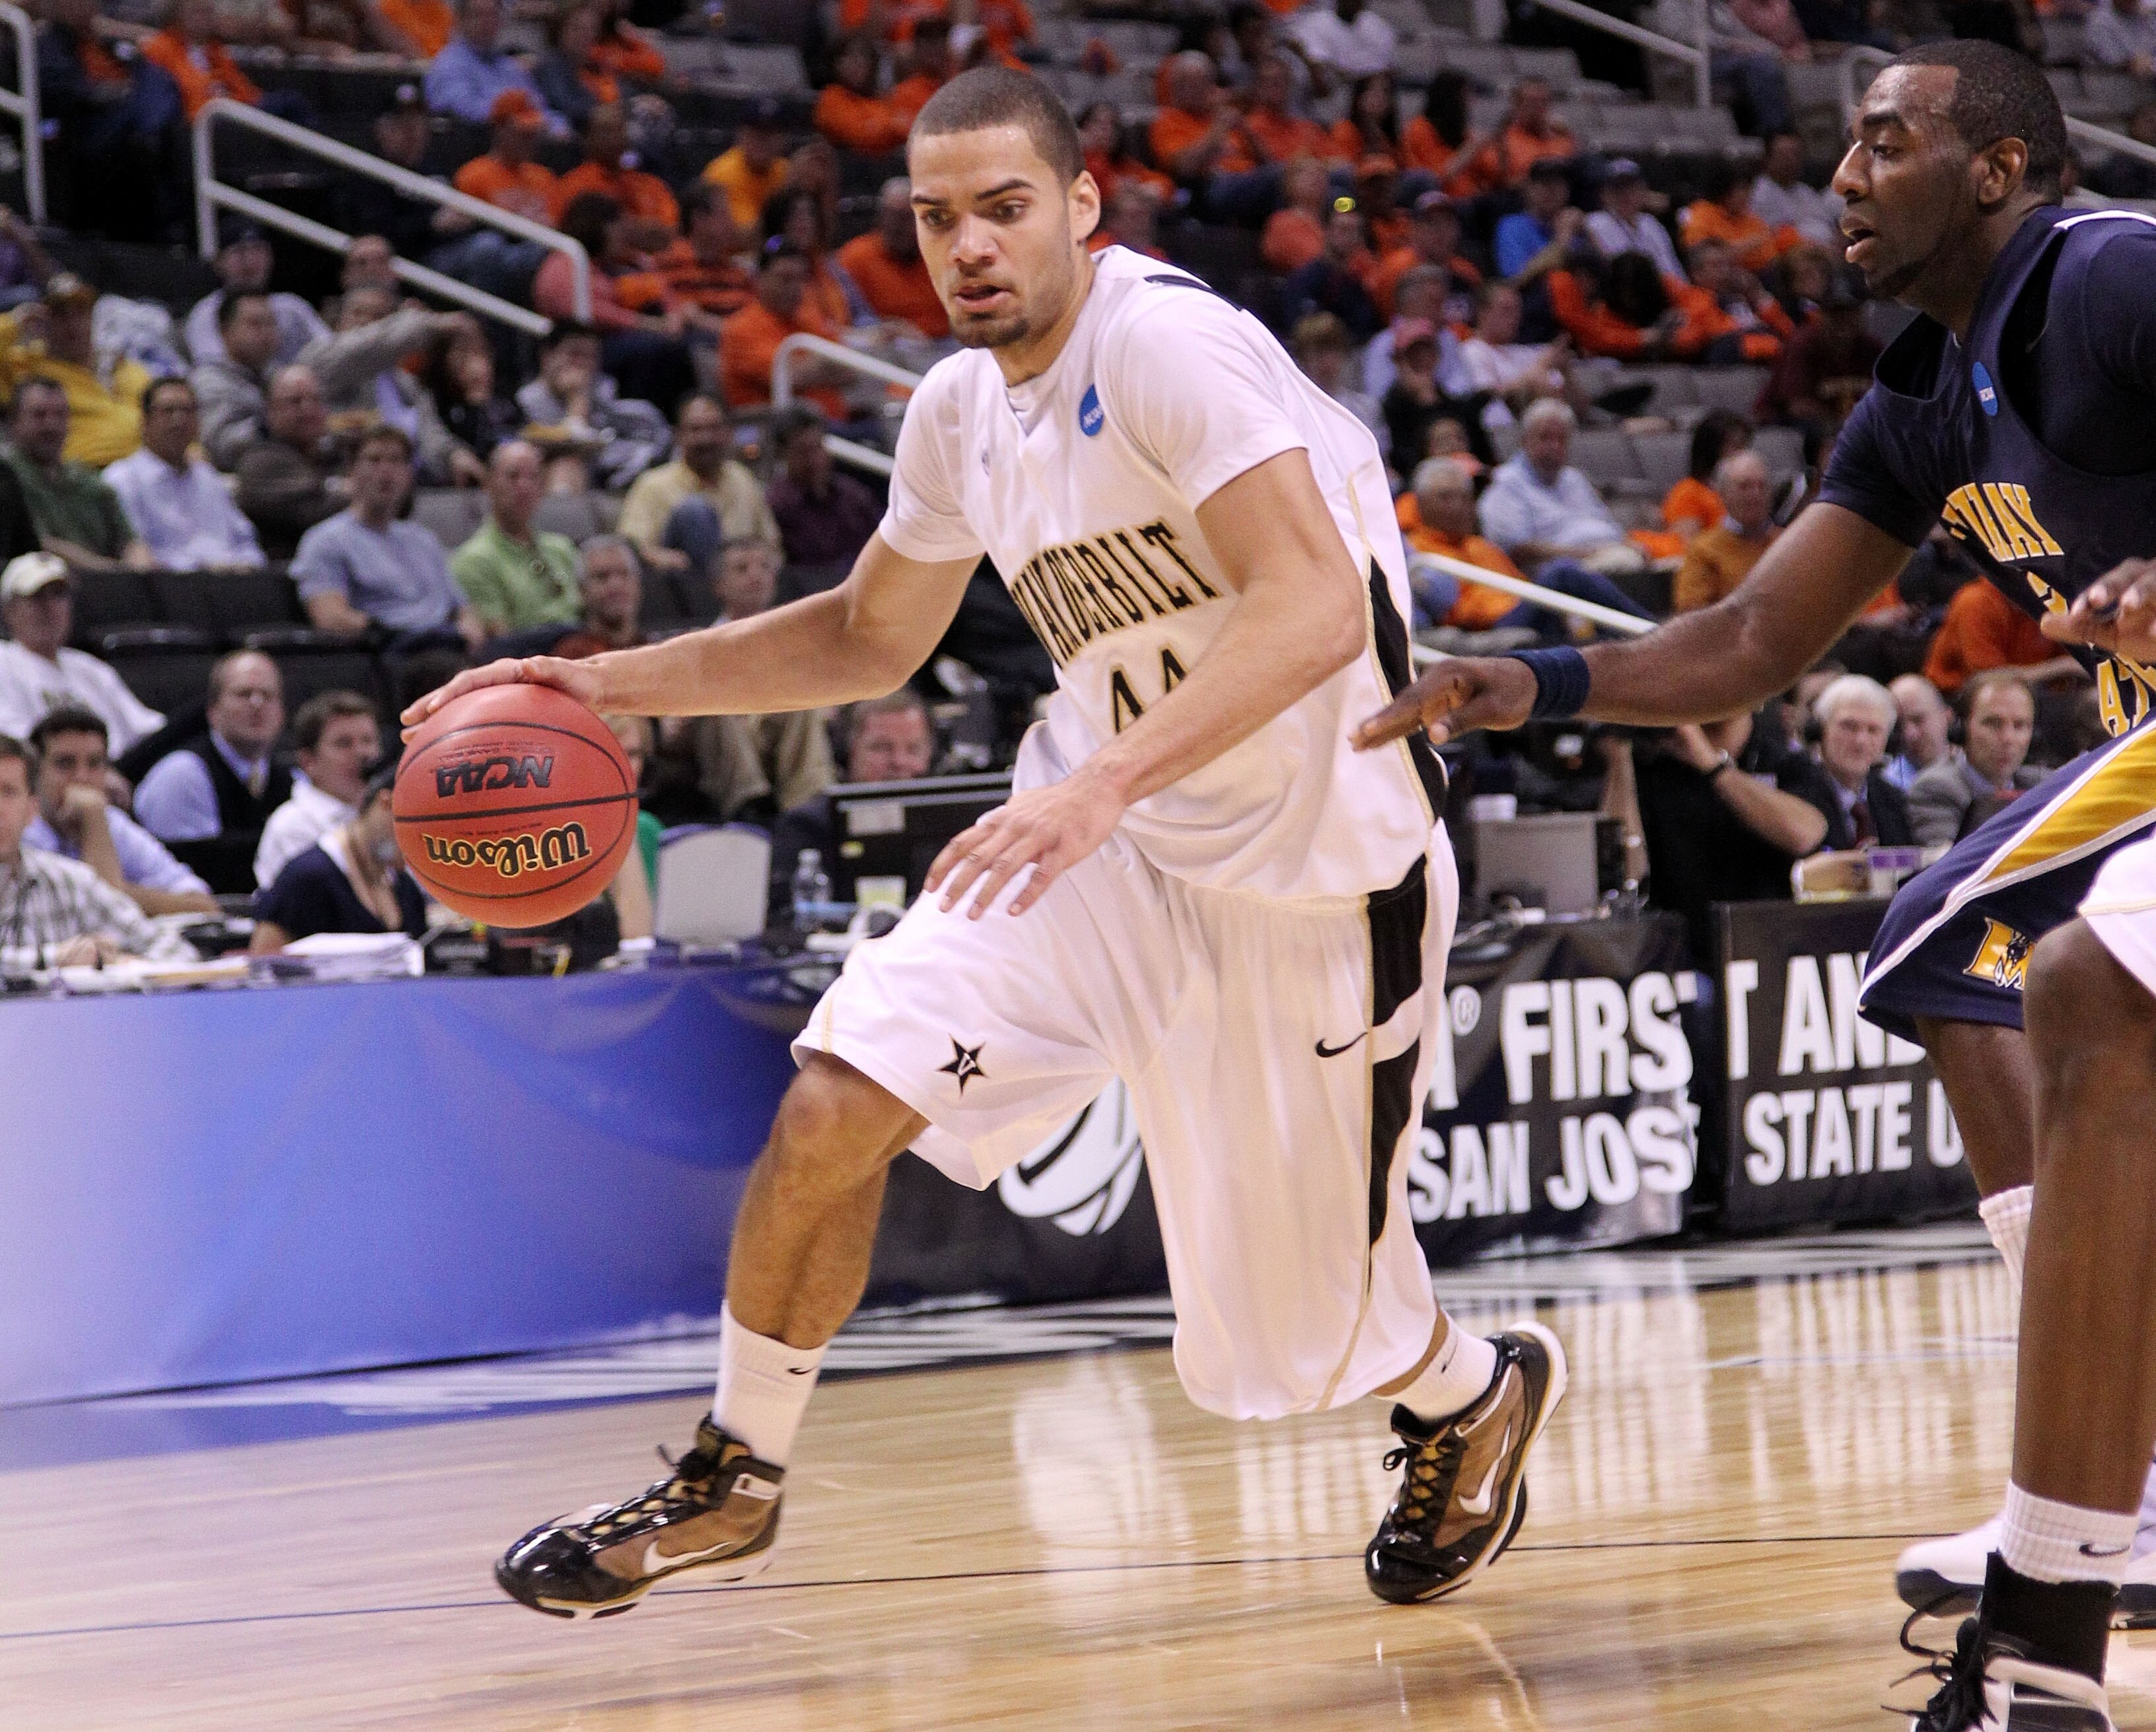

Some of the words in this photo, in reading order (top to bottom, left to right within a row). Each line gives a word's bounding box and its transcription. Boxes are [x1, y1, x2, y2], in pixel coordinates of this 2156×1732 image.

[437, 756, 554, 799] NCAA
[422, 821, 592, 878] Wilson
[1500, 970, 1698, 1105] FIRS
[1778, 951, 1927, 1076] AN
[1407, 1120, 1531, 1223] SAN
[1544, 1105, 1700, 1211] JOS
[1743, 1080, 1913, 1186] STATE
